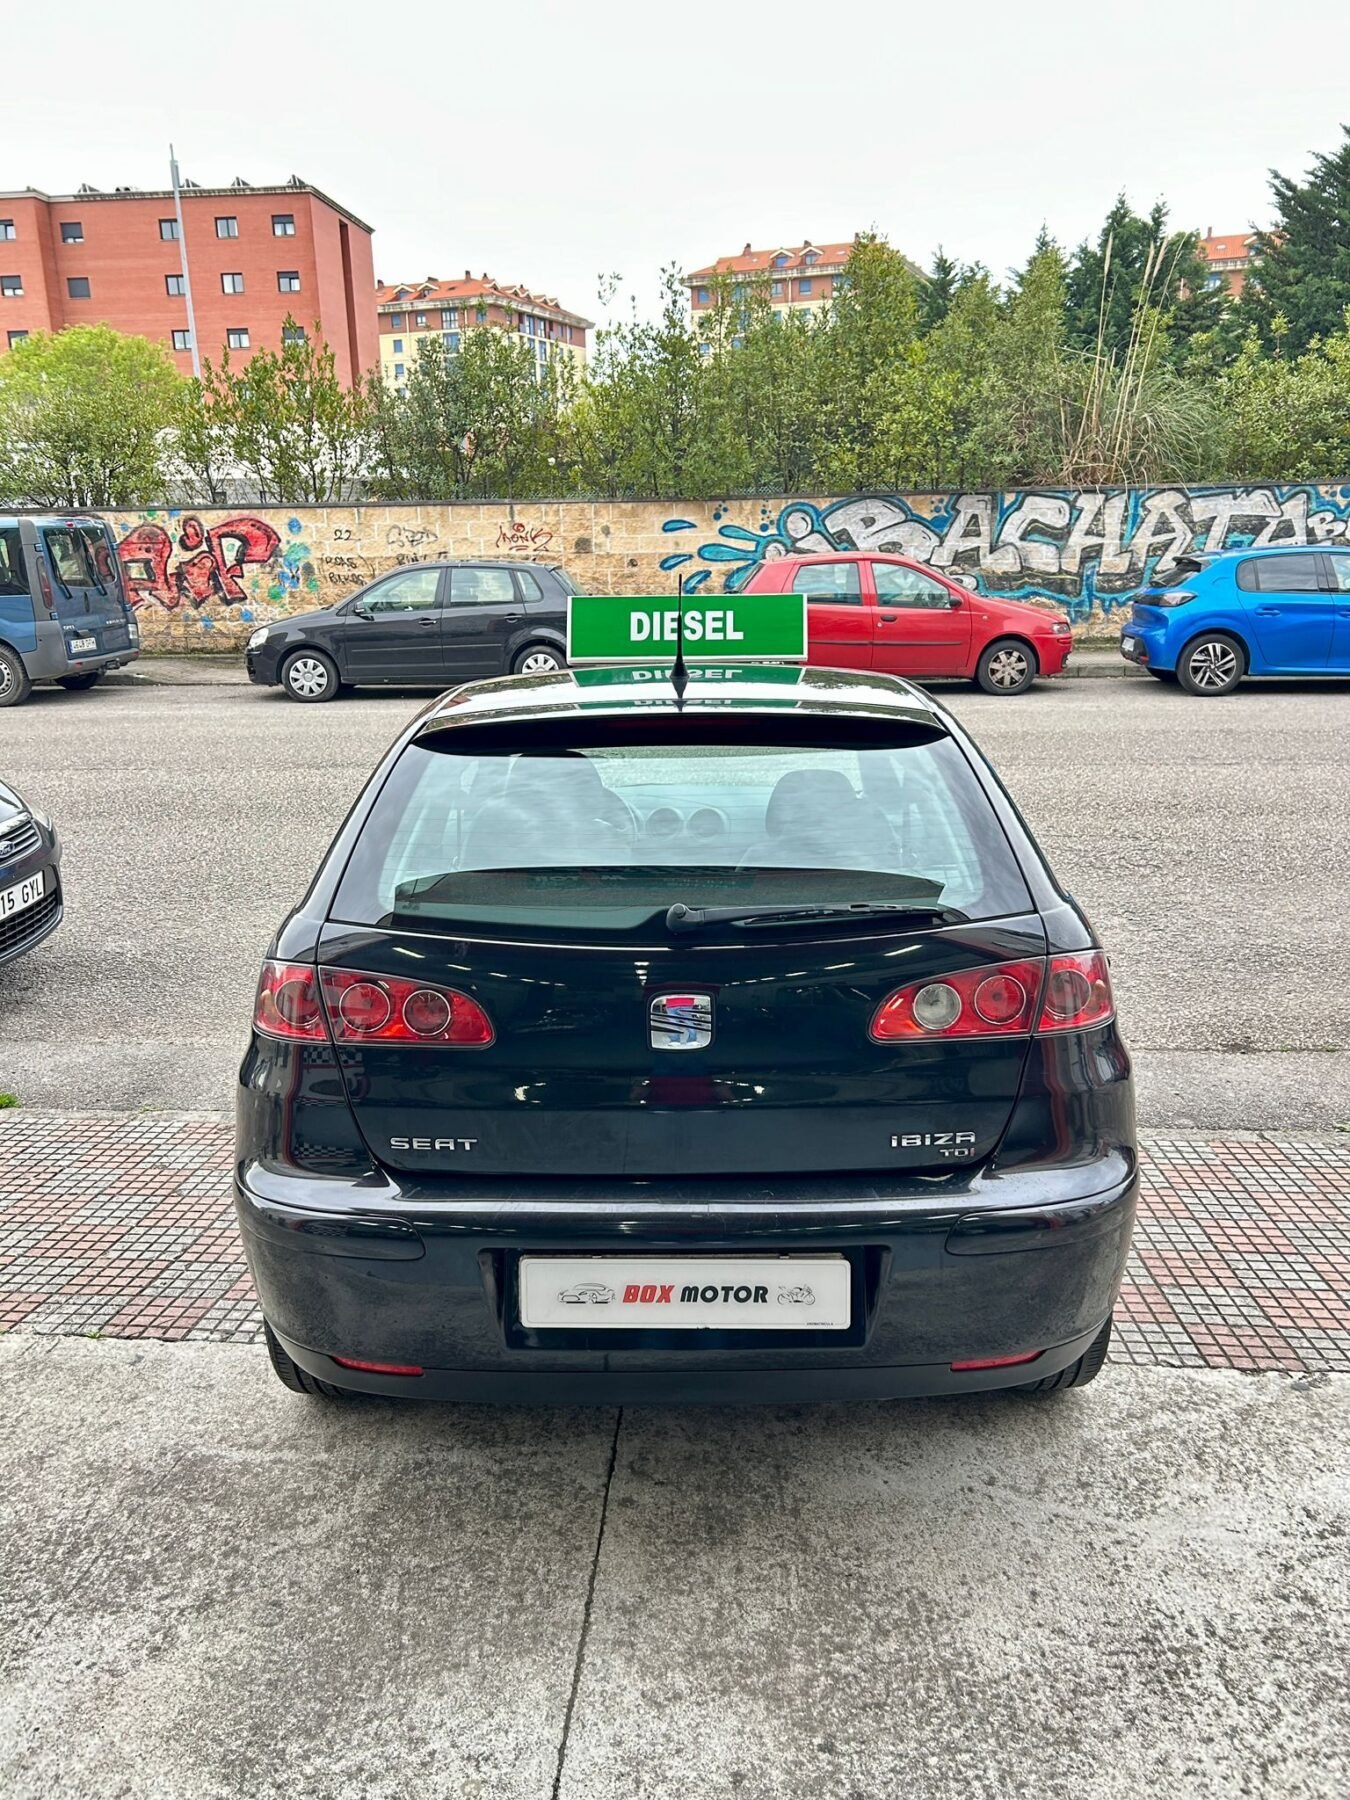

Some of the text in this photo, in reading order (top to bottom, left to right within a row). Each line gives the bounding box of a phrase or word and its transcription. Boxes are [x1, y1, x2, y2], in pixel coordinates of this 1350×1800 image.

[629, 610, 744, 641] DIESEL
[21, 876, 43, 904] GYL
[390, 1137, 478, 1151] SEAT
[622, 1284, 769, 1304] BOX MOTOR
